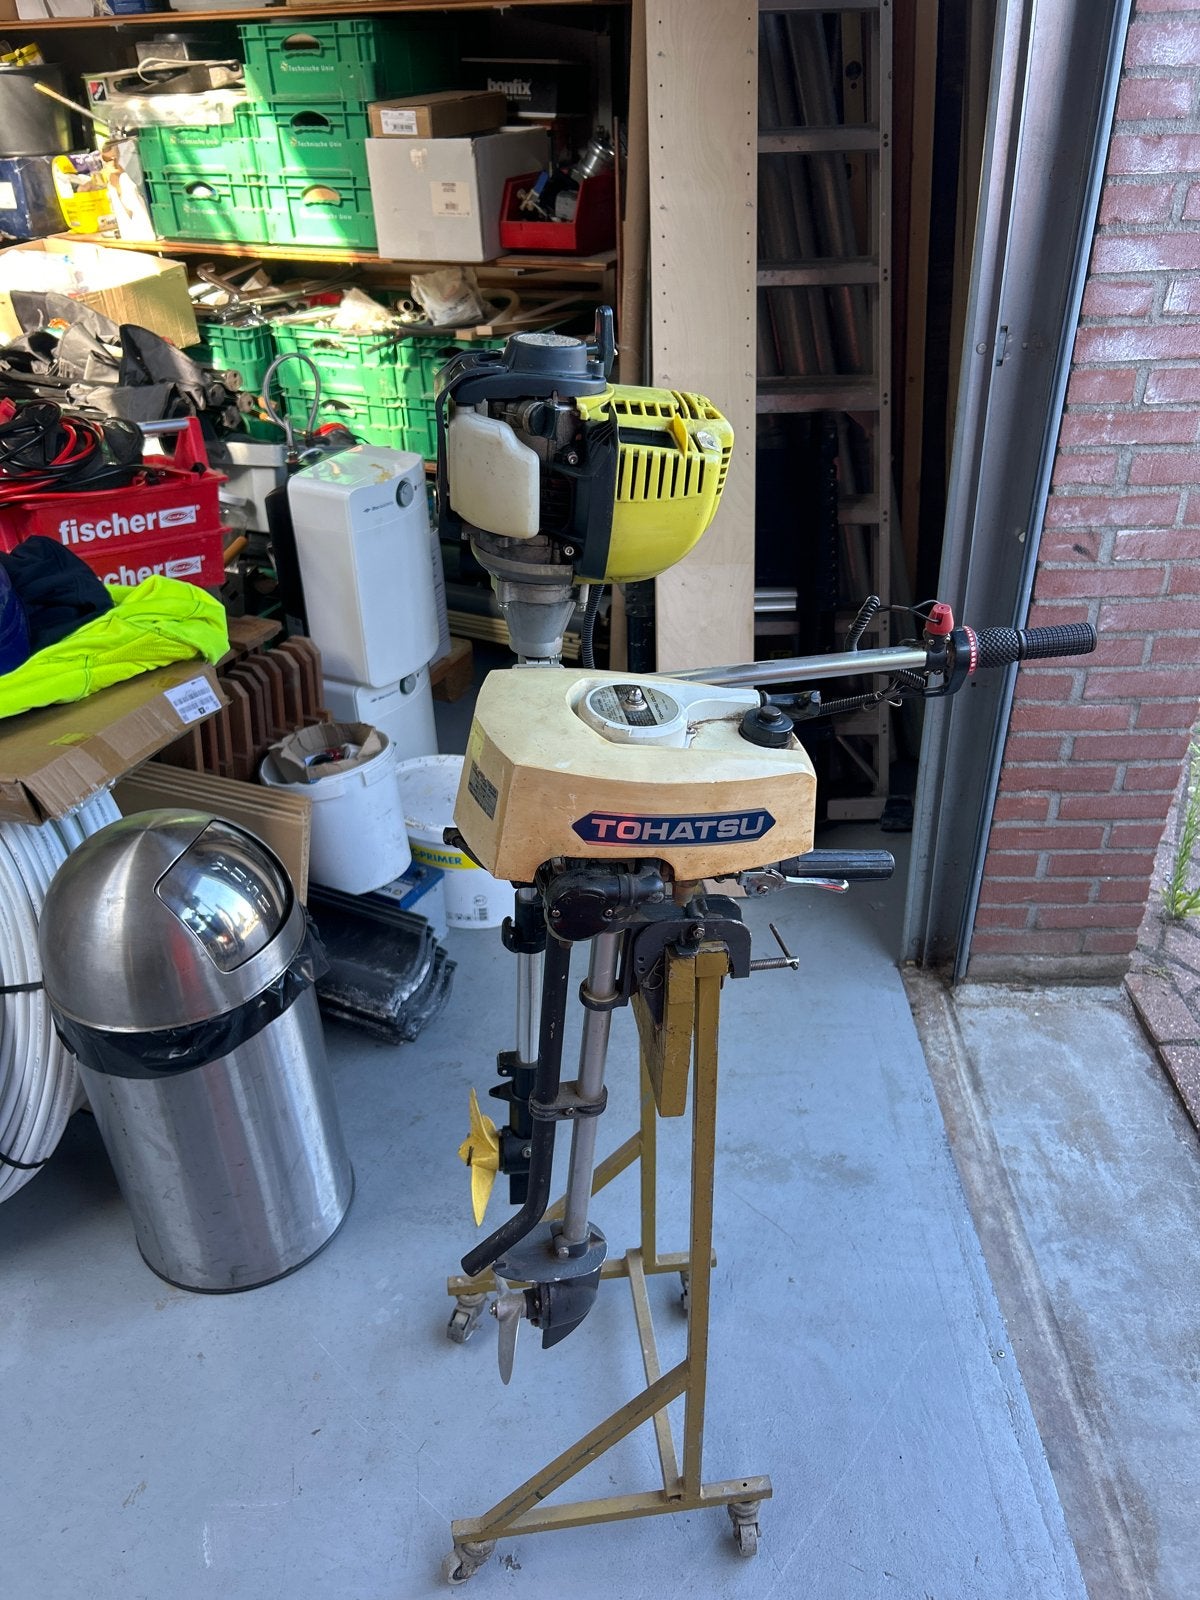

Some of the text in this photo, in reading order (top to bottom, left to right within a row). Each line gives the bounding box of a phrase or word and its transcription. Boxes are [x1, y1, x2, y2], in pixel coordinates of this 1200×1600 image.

[487, 78, 531, 94] bonfix
[59, 512, 157, 545] fischer
[98, 564, 164, 586] cher
[591, 815, 765, 841] TOHATSU
